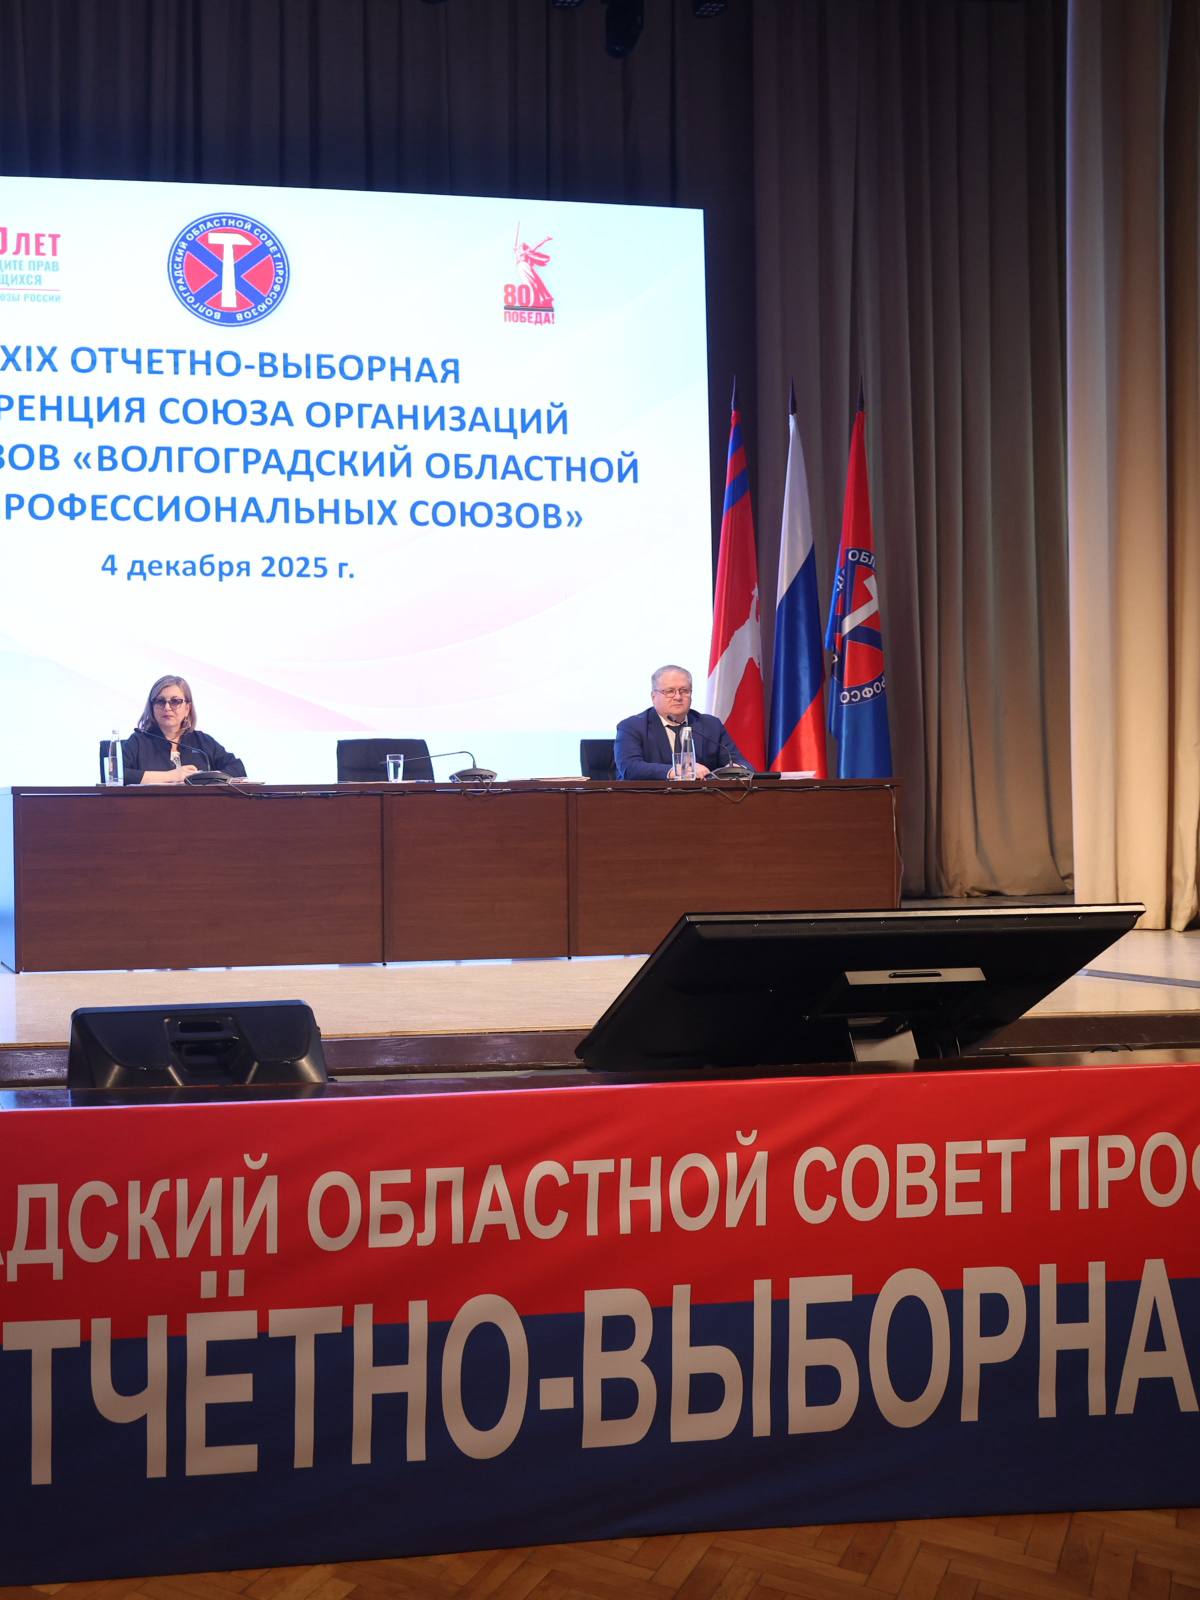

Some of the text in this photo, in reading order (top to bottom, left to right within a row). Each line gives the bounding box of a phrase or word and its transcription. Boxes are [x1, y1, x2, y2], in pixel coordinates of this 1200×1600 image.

[12, 232, 61, 257] ЛЕТ
[186, 218, 252, 241] ОБЛАСТНОЙ
[253, 228, 283, 259] СОВЕТ
[28, 261, 60, 272] ПРАВ
[235, 261, 284, 321] ПРОФСОЮЗОВ
[504, 283, 531, 307] 80
[504, 311, 555, 326] ПОБЕДА!
[70, 346, 460, 385] ОТЧЕТНО-ВЫБОРНАЯ
[159, 397, 294, 428] СОЮЗА
[305, 402, 568, 440] ОРГАНИЗАЦИЙ
[73, 445, 411, 483] «ВОЛГОГРАДСКИЙ
[425, 450, 639, 484] ОБЛАСТНОЙ
[409, 500, 583, 529] СОЮЗОВ»
[101, 553, 355, 583] 4 декабря 2025 г.
[307, 1129, 768, 1252] ОБЛАСТНОЙ
[792, 1138, 1026, 1224] СОВЕТ
[1049, 1131, 1200, 1212] ПРО
